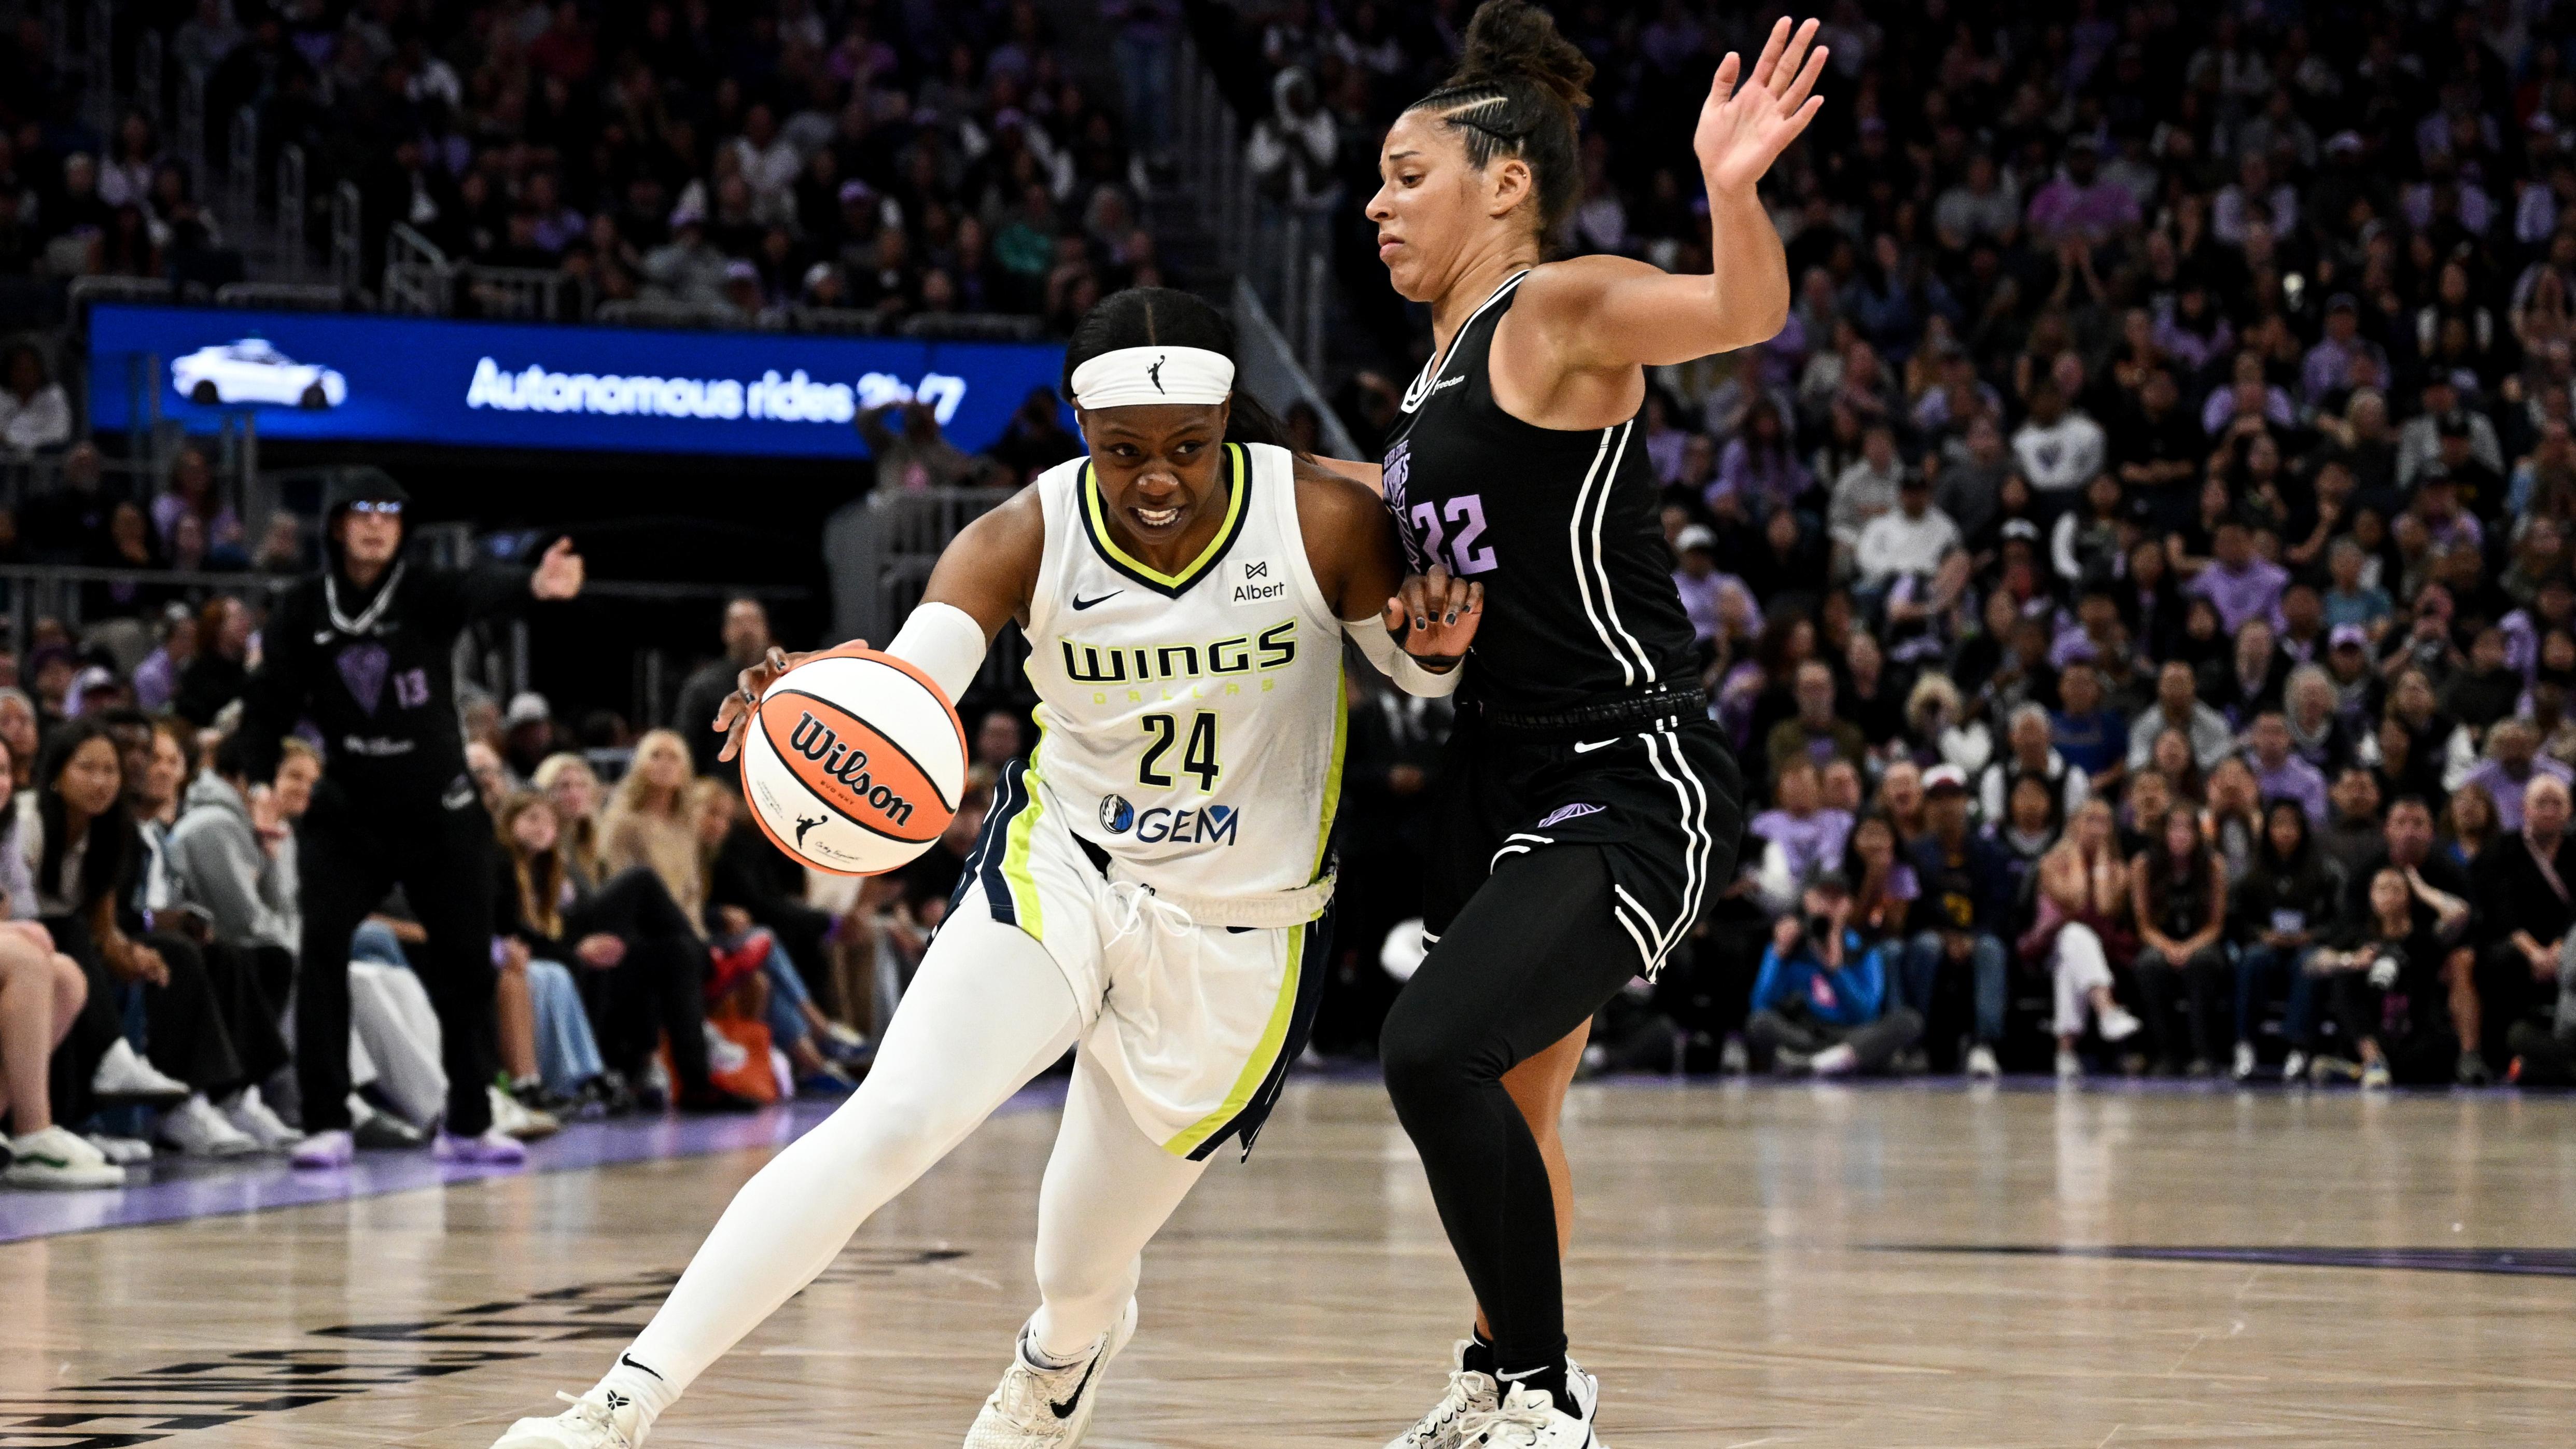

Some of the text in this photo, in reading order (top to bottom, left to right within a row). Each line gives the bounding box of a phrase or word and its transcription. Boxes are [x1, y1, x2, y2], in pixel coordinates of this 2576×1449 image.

[466, 356, 743, 419] Autonomous
[746, 369, 855, 424] rides
[1432, 375, 1465, 396] freedom
[1411, 494, 1498, 576] 22
[1234, 581, 1284, 602] Albert
[1058, 616, 1298, 685] WINGS
[392, 667, 430, 710] 13
[790, 710, 914, 828] Wilson
[1136, 708, 1223, 796] 24
[1136, 805, 1239, 846] GEM
